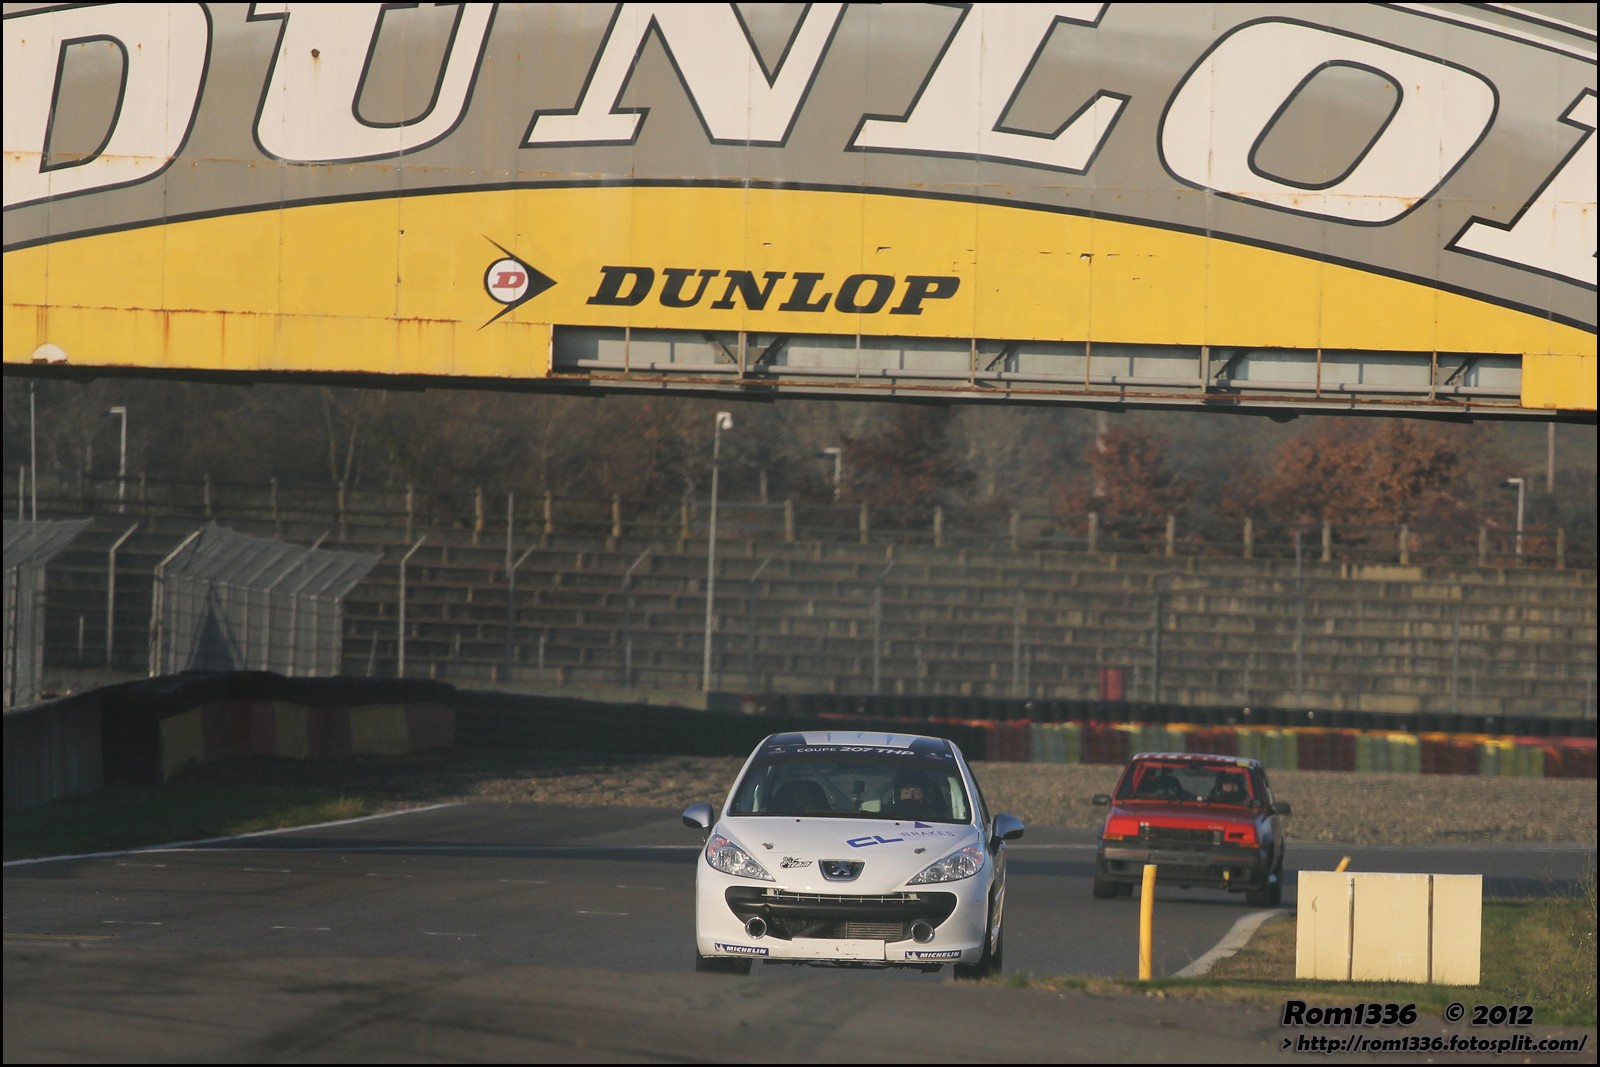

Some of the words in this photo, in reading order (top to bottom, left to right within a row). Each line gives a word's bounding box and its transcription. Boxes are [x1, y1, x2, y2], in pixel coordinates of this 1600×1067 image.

[492, 271, 525, 289] D
[586, 265, 960, 315] DUNLOP
[877, 748, 914, 756] THP
[900, 830, 955, 838] BRAKES
[846, 835, 904, 848] CL
[726, 945, 767, 955] MICHELIN
